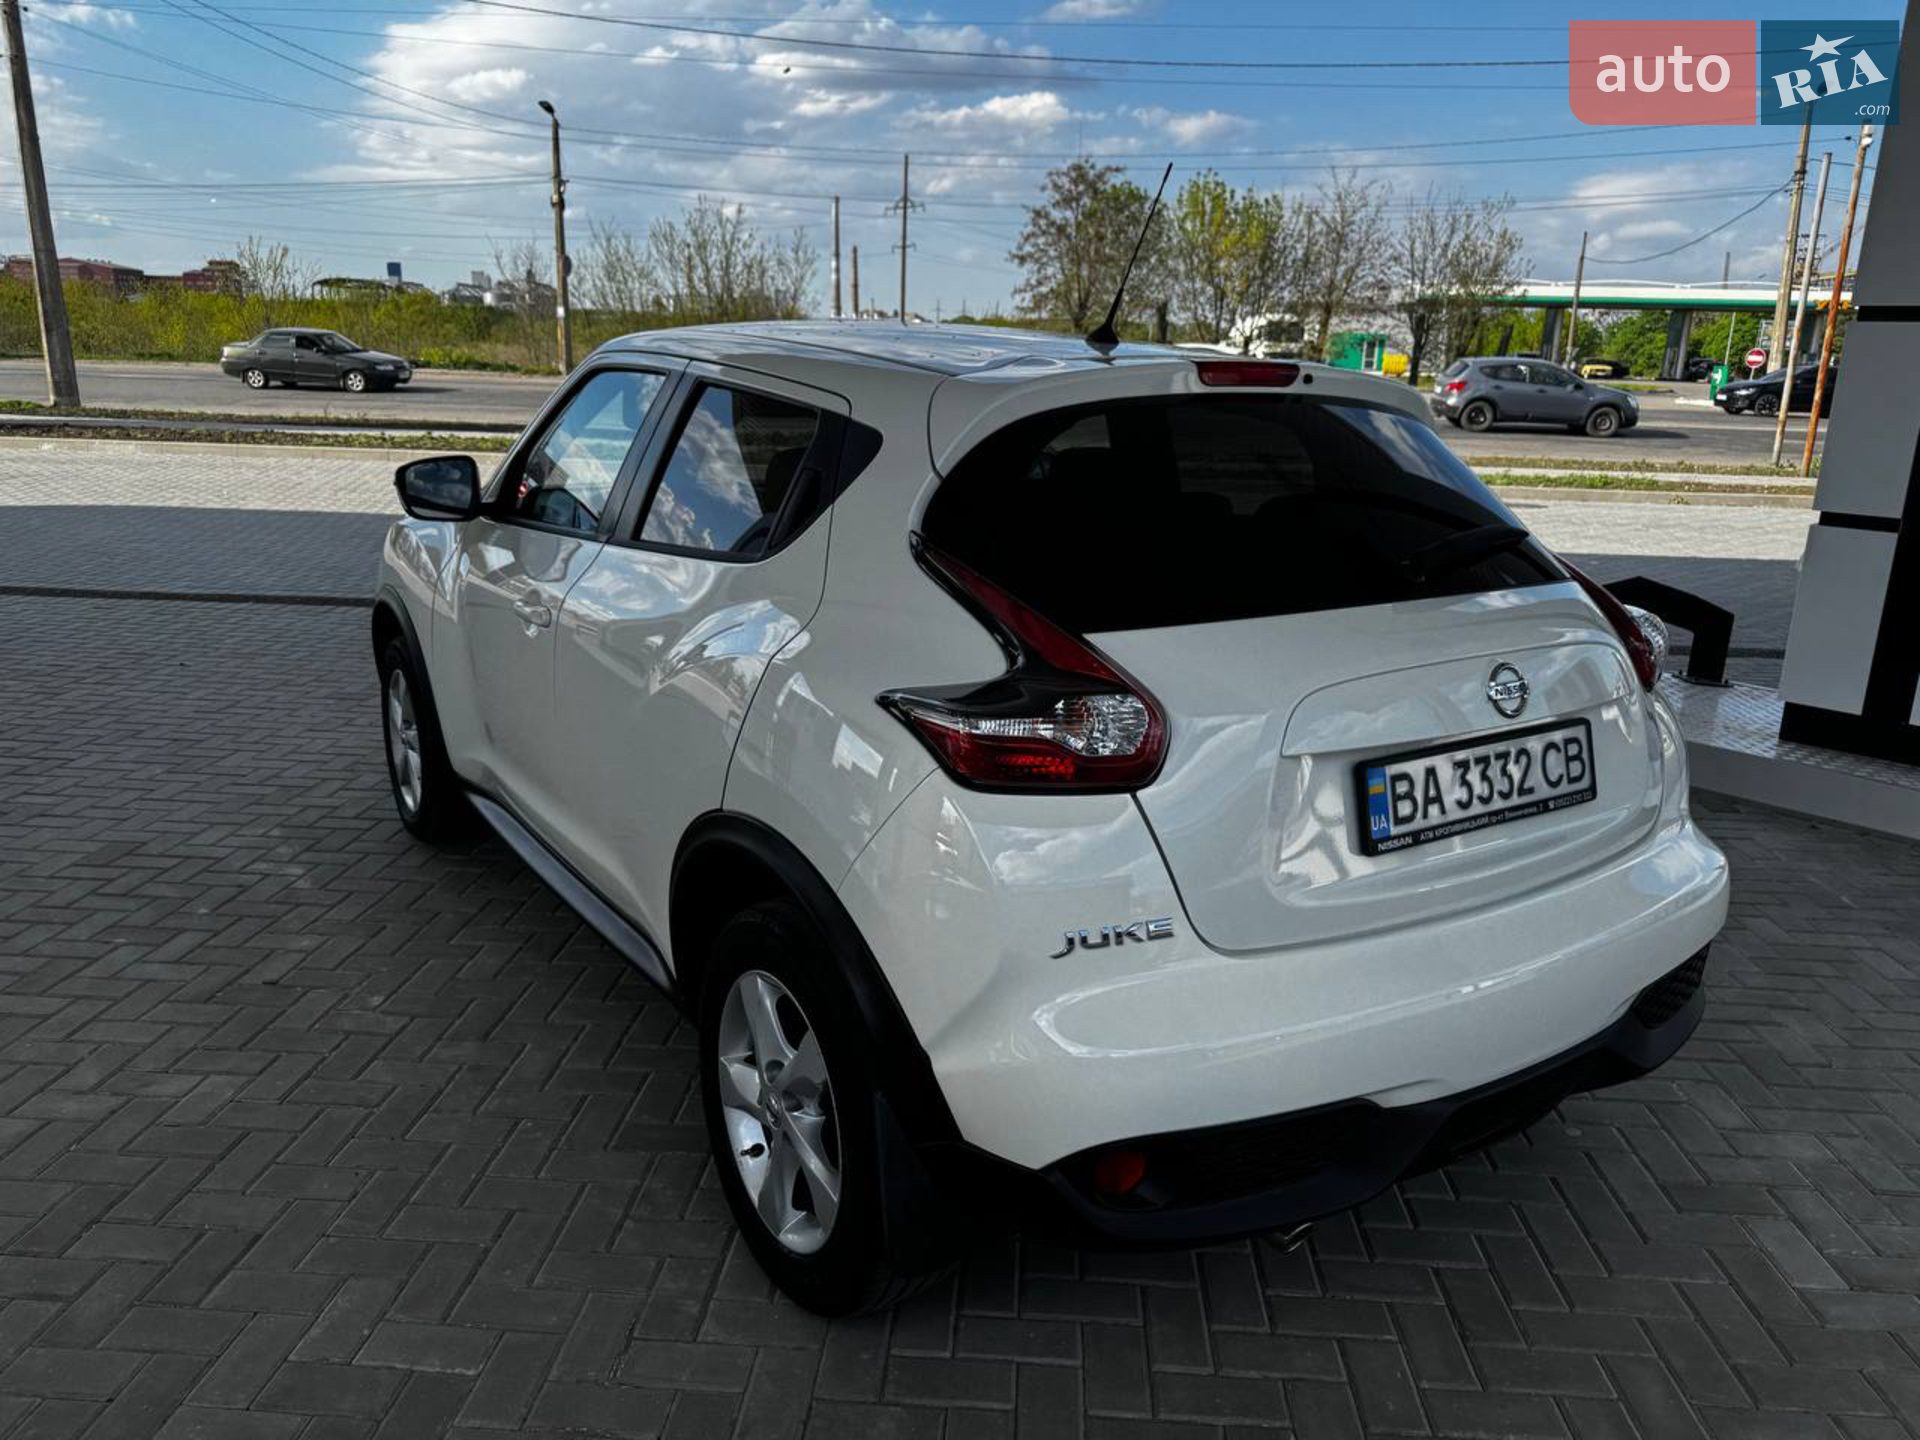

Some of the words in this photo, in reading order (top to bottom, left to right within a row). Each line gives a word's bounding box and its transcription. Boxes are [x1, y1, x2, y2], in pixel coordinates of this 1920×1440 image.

[1390, 766, 1447, 826] BA
[1453, 747, 1535, 810] 3332
[1541, 736, 1587, 789] CB
[1371, 814, 1389, 830] UA
[1377, 835, 1413, 852] NISSAN
[1048, 917, 1175, 959] JUKE
